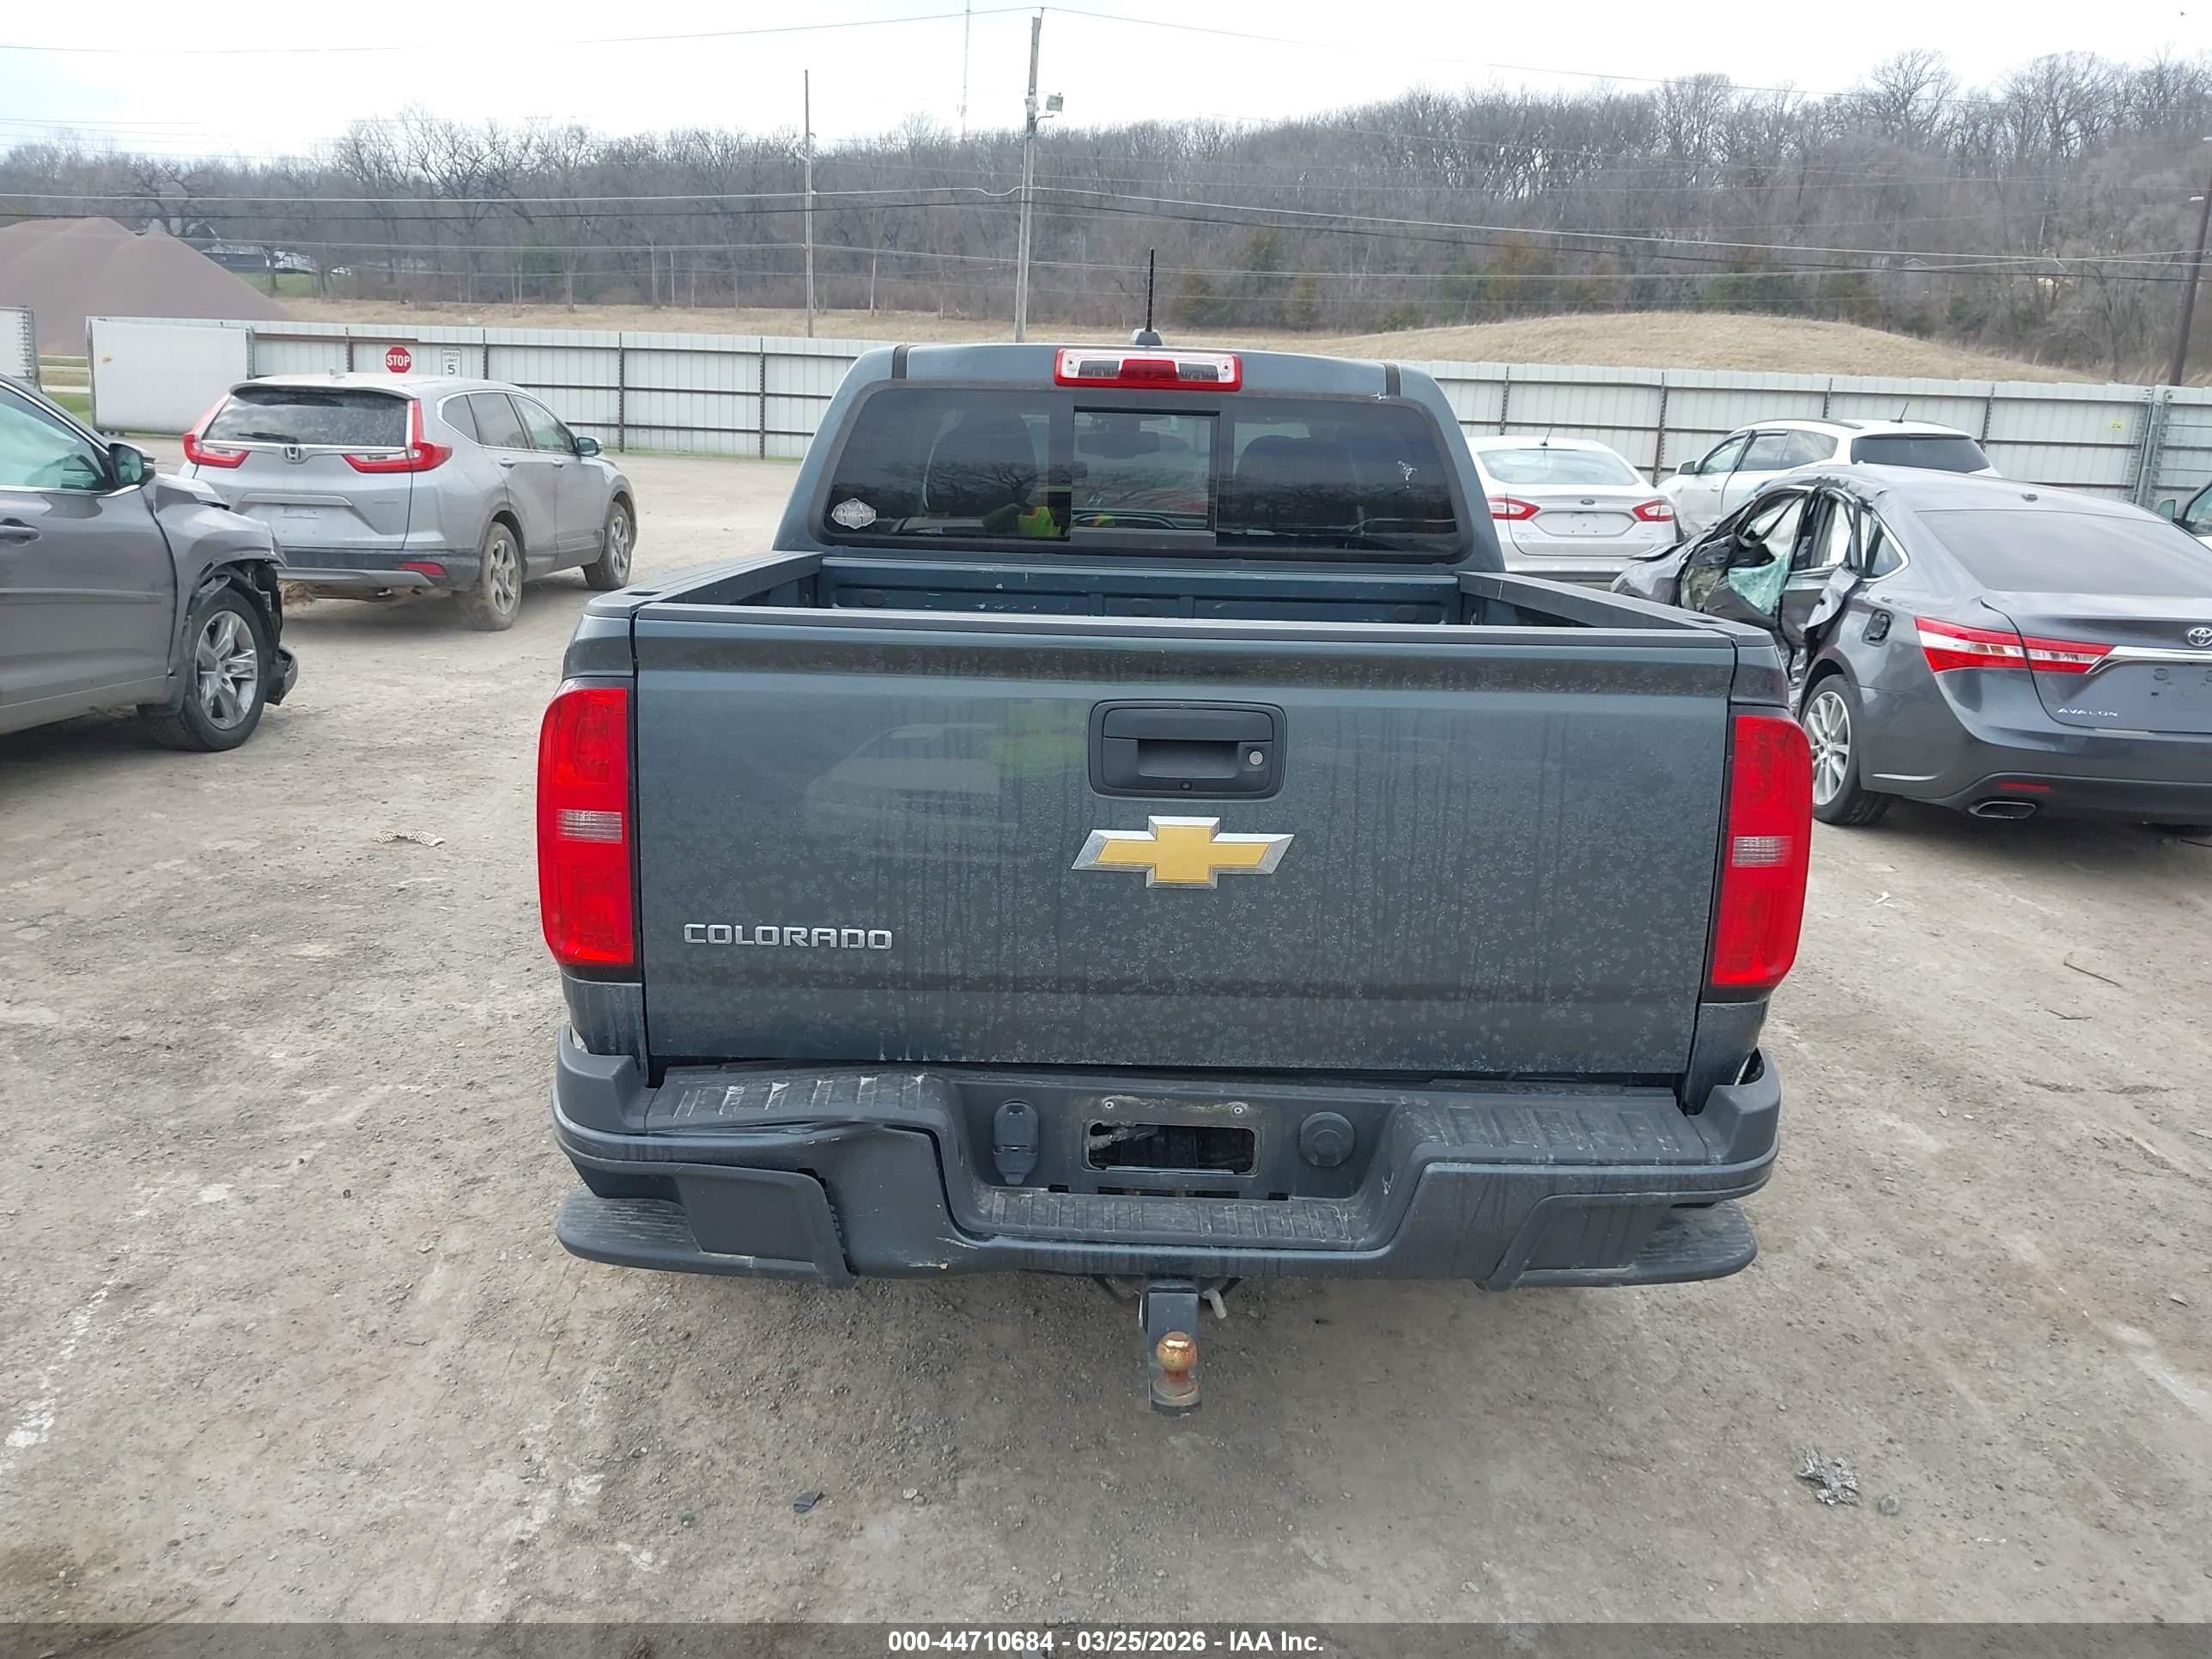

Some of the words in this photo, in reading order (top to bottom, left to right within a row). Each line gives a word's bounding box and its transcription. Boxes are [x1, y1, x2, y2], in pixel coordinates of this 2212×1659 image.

[386, 355, 410, 367] STOP
[447, 364, 456, 375] 5
[2057, 708, 2118, 717] AVALON
[684, 923, 892, 950] COLORADO
